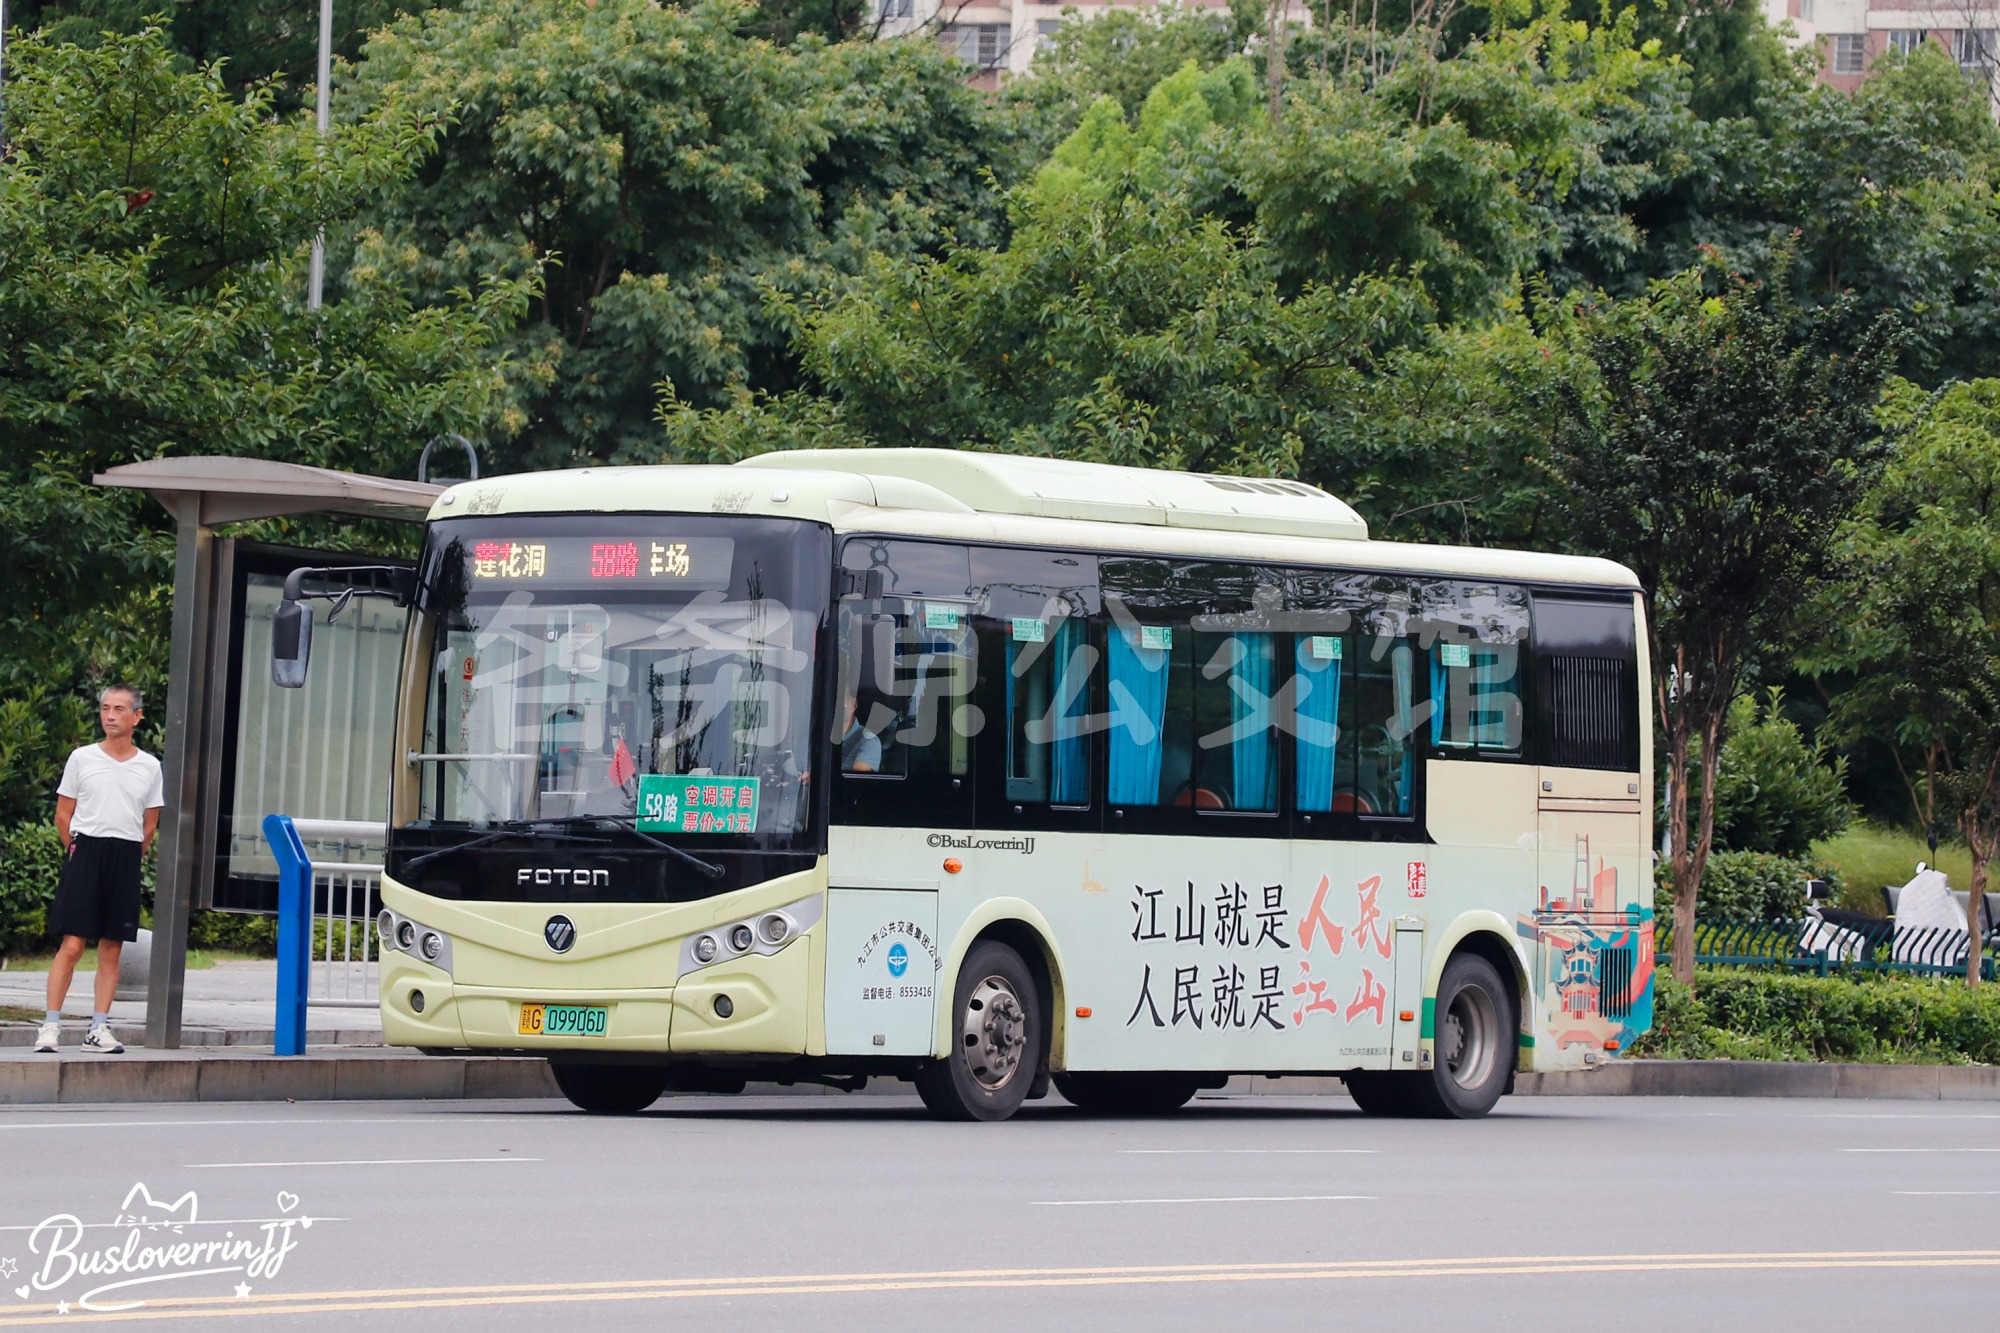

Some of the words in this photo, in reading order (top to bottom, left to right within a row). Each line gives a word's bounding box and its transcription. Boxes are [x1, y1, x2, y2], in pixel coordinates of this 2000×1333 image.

[474, 543, 546, 577] 莲花洞
[591, 543, 640, 577] 58路
[643, 793, 678, 823] 58路
[685, 785, 753, 808] 空调开启
[682, 811, 752, 833] 票价+1元
[516, 868, 610, 887] FOTON
[1131, 873, 1392, 959] 江山就是人民
[857, 919, 943, 971] 九江市公共交通集团公司
[1126, 961, 1386, 1030] 人民就是江山
